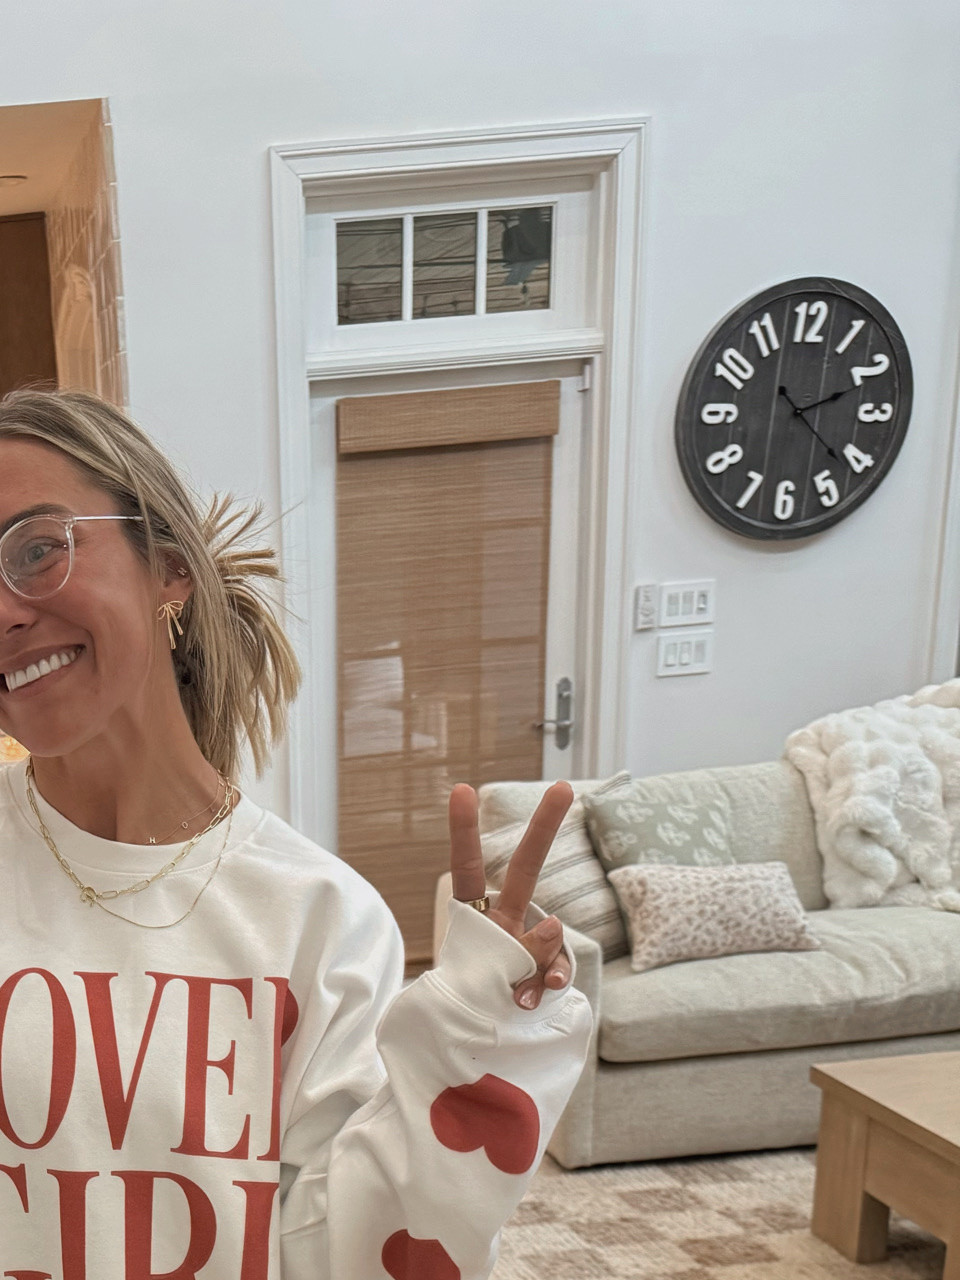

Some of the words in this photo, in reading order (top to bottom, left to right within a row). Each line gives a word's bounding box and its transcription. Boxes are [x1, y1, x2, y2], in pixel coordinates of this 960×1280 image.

[748, 312, 780, 358] 11
[793, 300, 829, 343] 12
[835, 319, 866, 354] 1
[715, 347, 755, 390] 10
[850, 353, 890, 387] 2
[701, 403, 739, 424] 9
[857, 402, 893, 423] 3
[706, 443, 744, 474] 8
[843, 443, 875, 474] 4
[736, 470, 764, 509] 7
[774, 480, 796, 520] 6
[813, 469, 840, 507] 5
